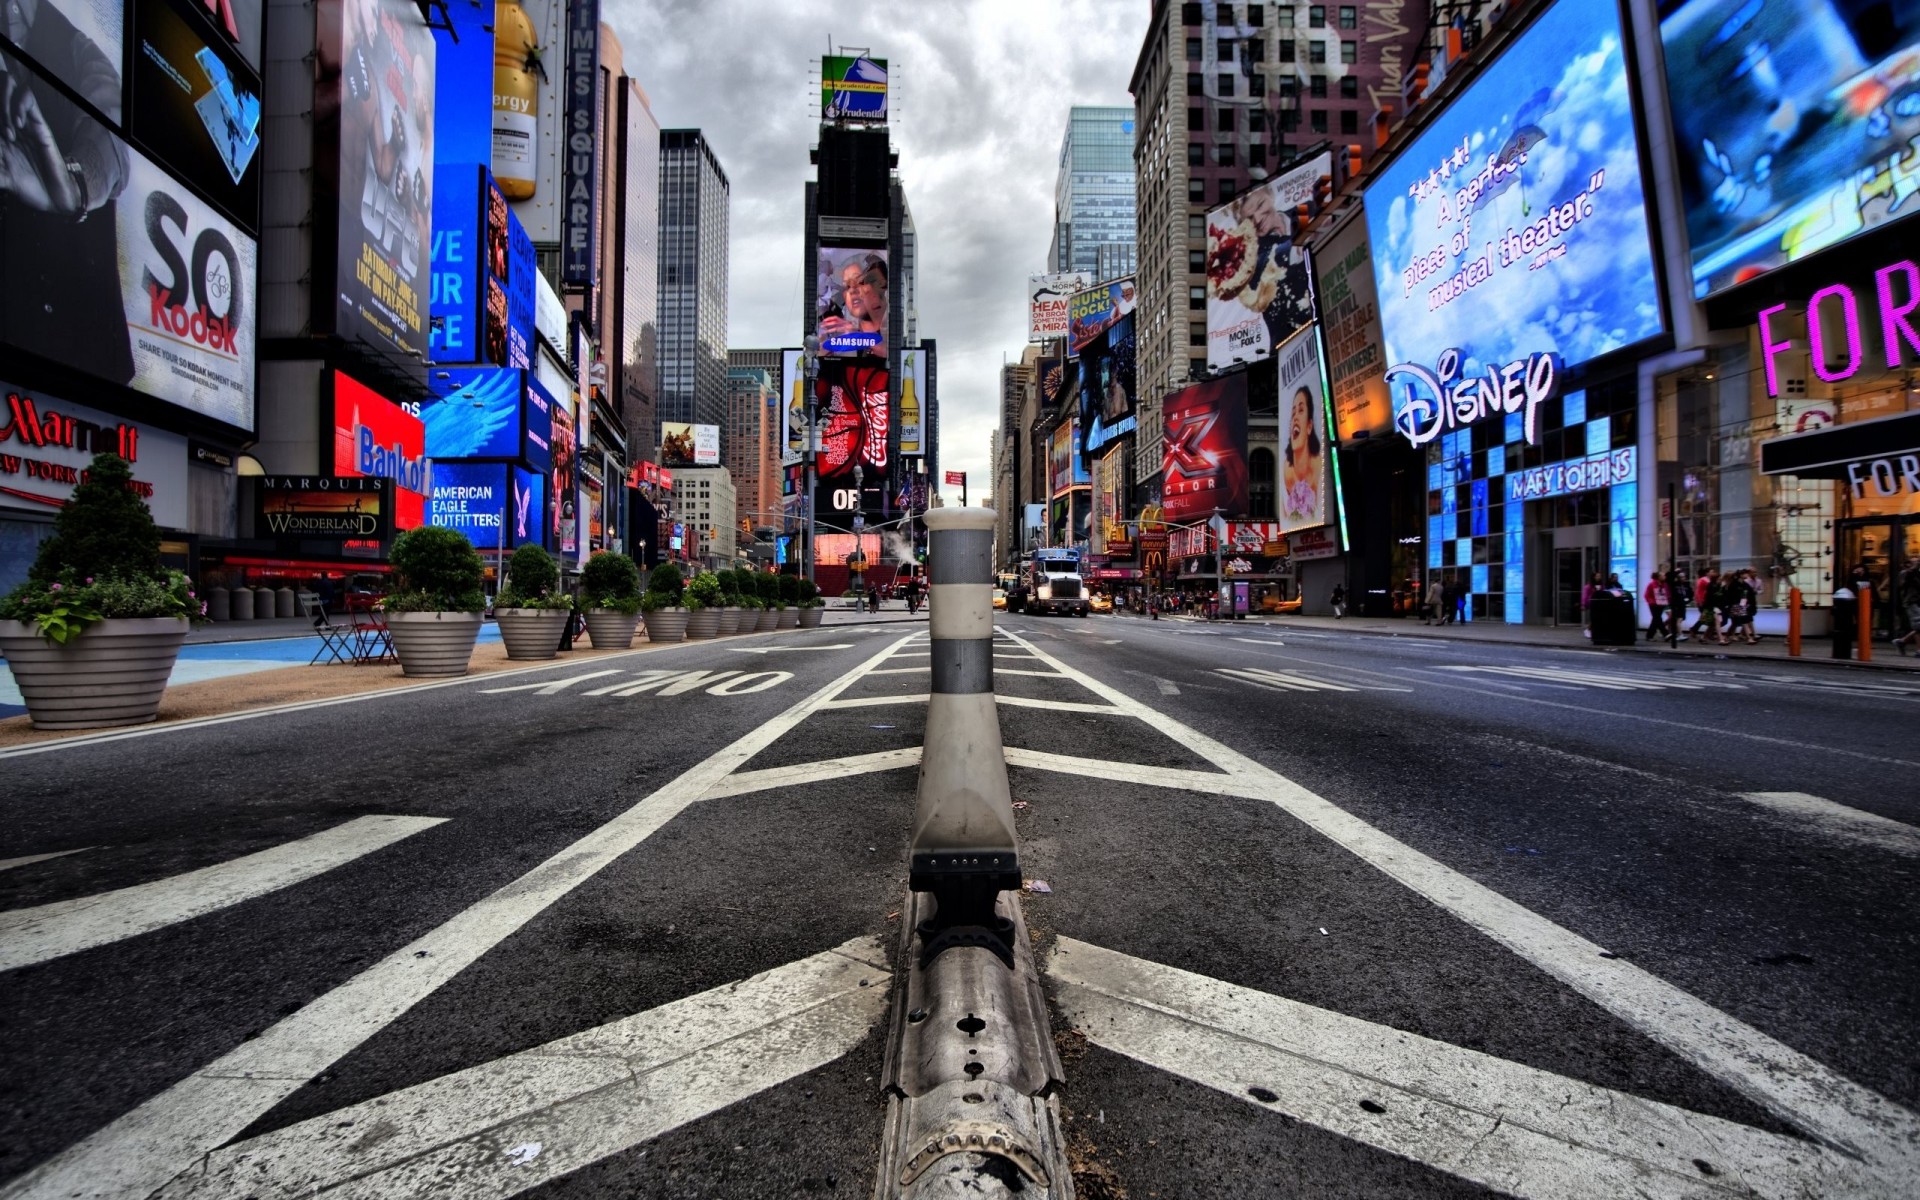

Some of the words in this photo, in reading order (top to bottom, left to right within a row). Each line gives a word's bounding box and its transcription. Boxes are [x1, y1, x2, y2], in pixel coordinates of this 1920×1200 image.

[571, 0, 594, 96] IMES
[841, 108, 885, 119] Prudential
[569, 109, 593, 249] SQUARE
[1277, 170, 1311, 192] WINNING
[361, 168, 419, 278] UFC
[1437, 195, 1452, 229] A
[142, 190, 243, 331] SO
[570, 264, 586, 272] NYC
[1404, 246, 1447, 298] piece
[1451, 215, 1471, 258] of
[356, 257, 372, 290] LIVE
[1428, 242, 1494, 311] musical
[398, 278, 412, 307] JUNE
[1072, 287, 1110, 308] NUNS
[148, 281, 239, 356] Kodak
[1071, 298, 1110, 320] ROCK!
[1033, 324, 1041, 332] A
[1042, 322, 1068, 331] MIRA
[1229, 328, 1249, 343] MON
[1240, 336, 1255, 348] FOX
[1256, 333, 1262, 343] 5
[830, 337, 876, 346] SAMSUNG
[139, 338, 161, 357] SHARE
[162, 349, 178, 365] YOUR
[179, 356, 187, 368] SO
[187, 360, 207, 377] KODAK
[207, 369, 230, 387] MOMENT
[230, 378, 243, 393] HERE
[1281, 345, 1306, 387] MAMMA
[862, 387, 888, 467] Coca-Cola
[355, 423, 408, 487] Bank
[26, 458, 78, 485] YORK
[263, 478, 382, 490] MARQUIS
[1511, 467, 1555, 499] MARY
[432, 500, 468, 513] EAGLE
[433, 486, 492, 500] AMERICAN
[1173, 498, 1191, 508] FALL
[432, 513, 501, 527] OUTFITTERS
